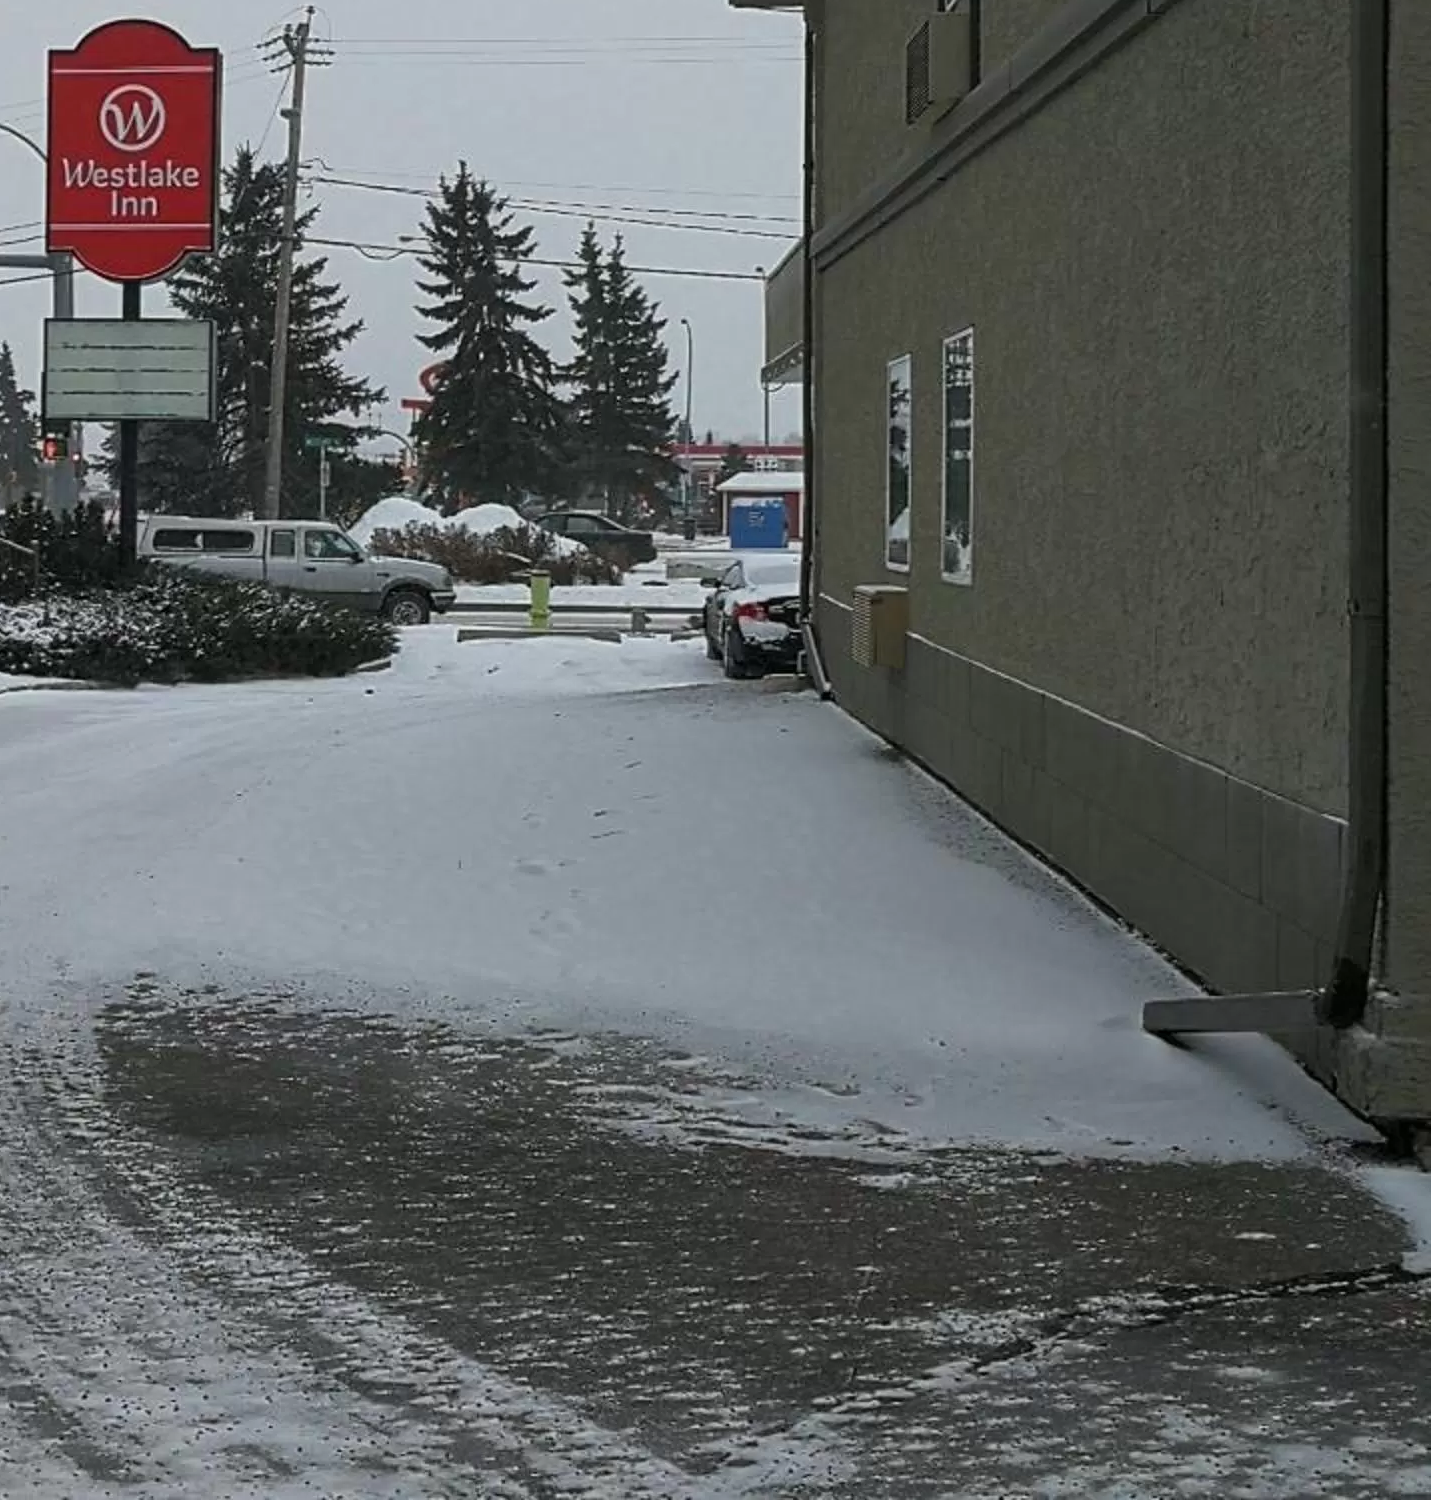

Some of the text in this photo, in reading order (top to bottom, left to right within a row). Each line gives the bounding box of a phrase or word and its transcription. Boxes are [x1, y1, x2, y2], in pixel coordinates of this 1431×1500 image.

[104, 97, 161, 142] W
[62, 157, 200, 188] Westlake
[111, 190, 158, 217] Inn
